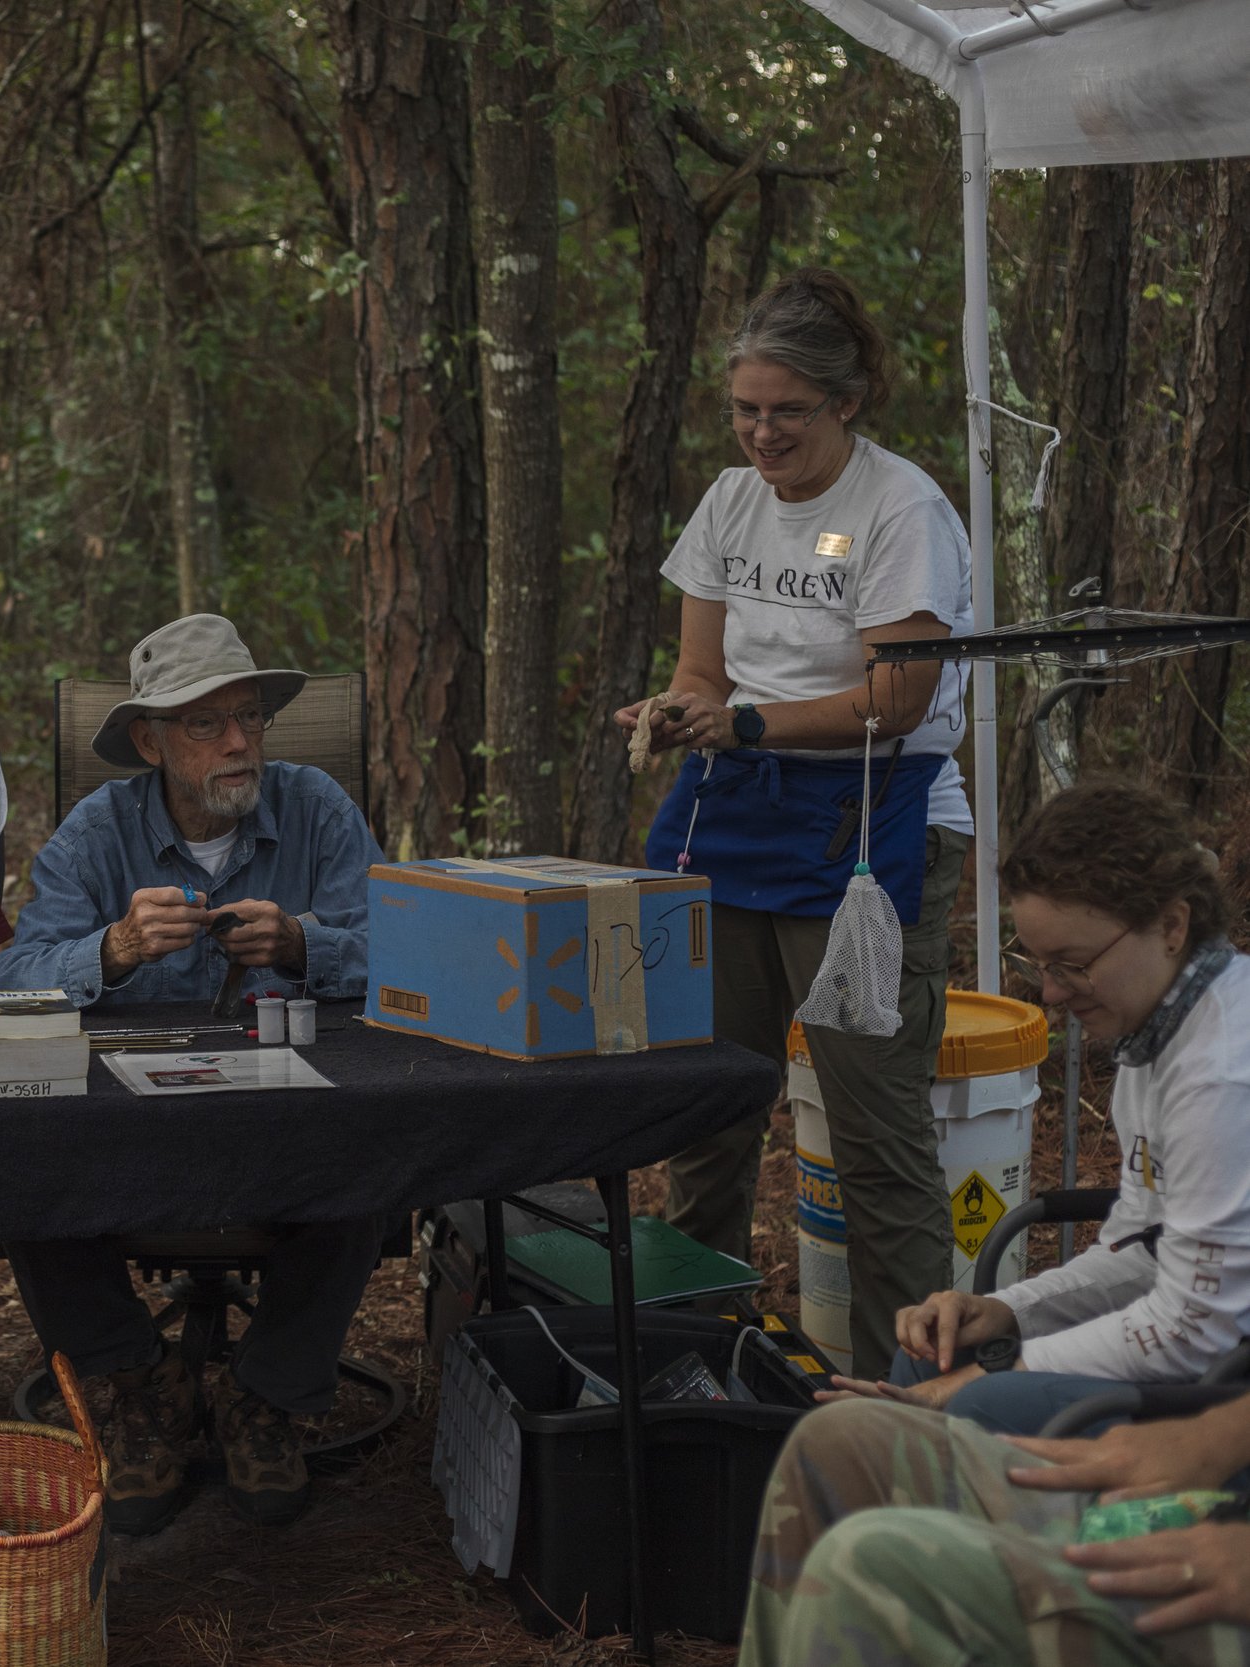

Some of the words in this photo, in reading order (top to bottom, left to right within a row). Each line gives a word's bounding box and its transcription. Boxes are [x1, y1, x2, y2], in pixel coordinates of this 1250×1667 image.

[776, 568, 847, 601] CREW
[958, 1215, 988, 1227] OXIDIZER
[966, 1238, 979, 1249] 5.1
